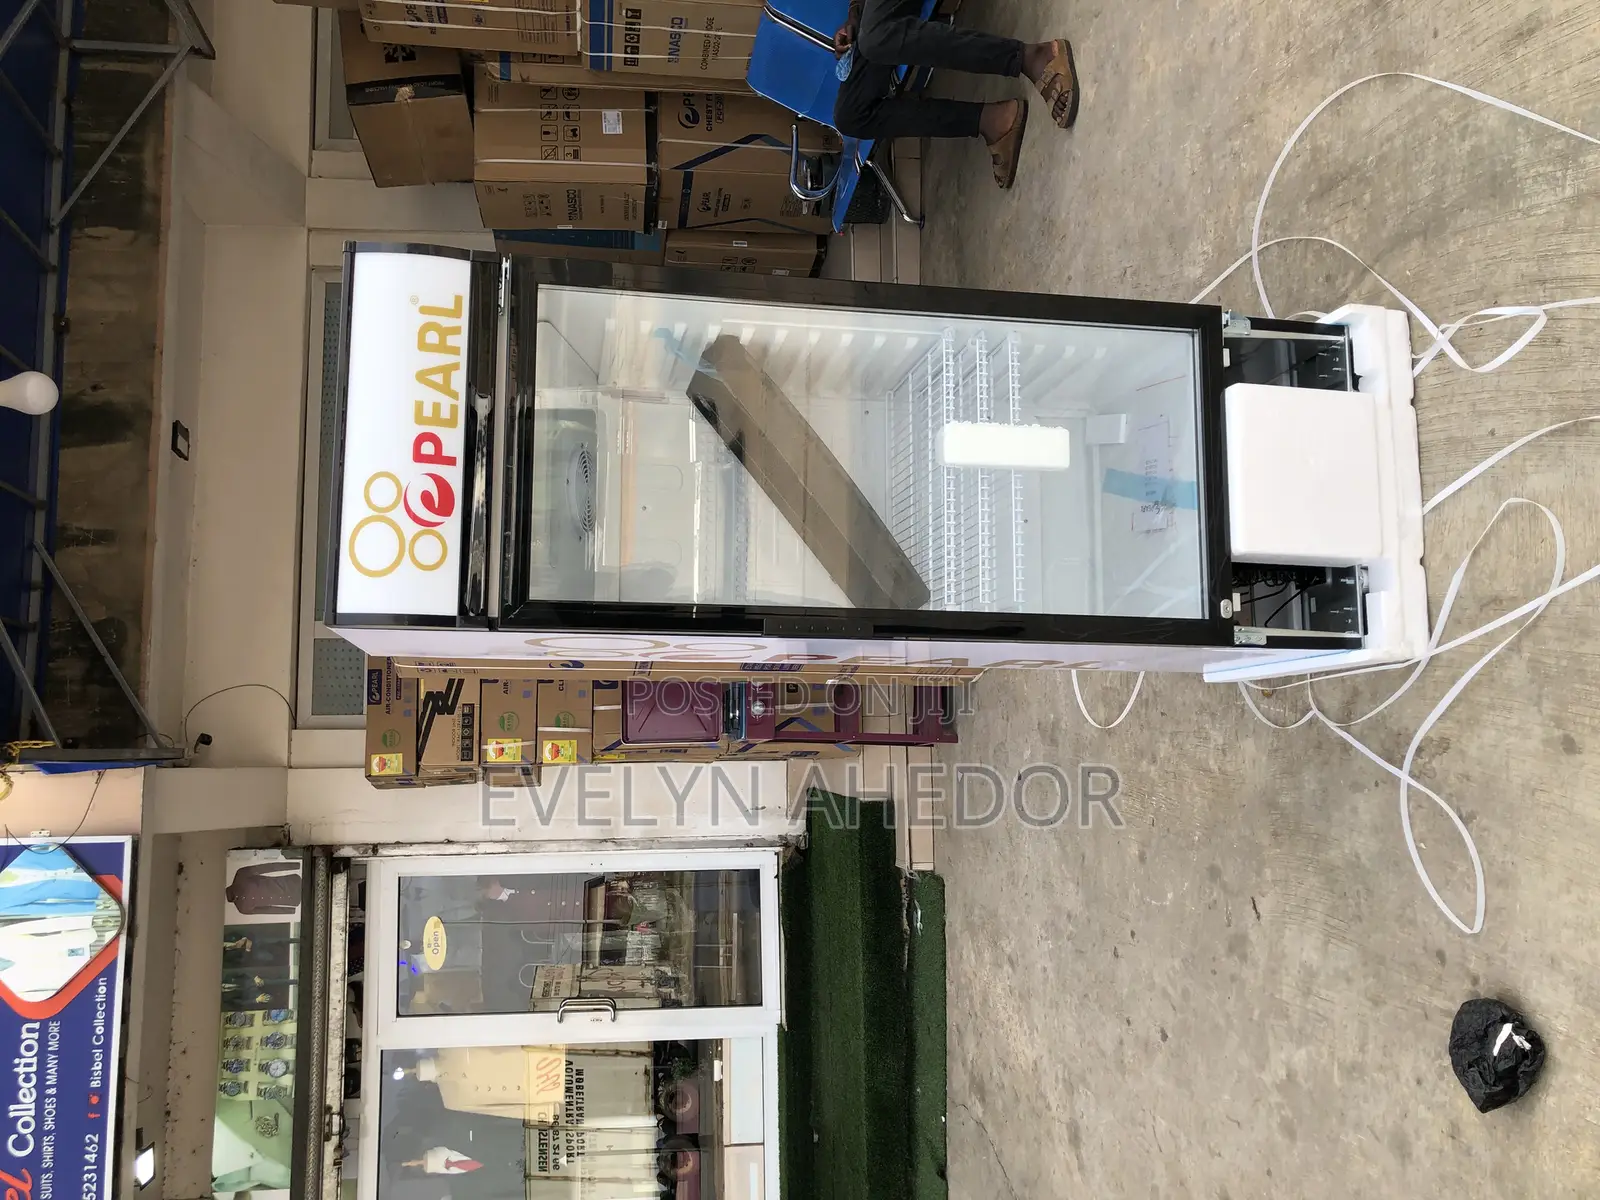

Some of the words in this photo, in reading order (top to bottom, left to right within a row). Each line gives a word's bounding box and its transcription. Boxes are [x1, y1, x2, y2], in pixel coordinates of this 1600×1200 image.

[700, 40, 711, 70] COMBINED
[567, 189, 578, 215] NASCO
[412, 294, 463, 467] PEARL
[432, 931, 440, 954] Open
[93, 977, 108, 1045] Collection
[49, 1020, 60, 1050] MORE
[48, 1054, 59, 1084] MANY
[90, 1050, 104, 1088] Bisbel
[7, 1022, 40, 1157] Collection
[45, 1098, 57, 1130] SHOES
[42, 1133, 56, 1168] SHIRTS,
[83, 1134, 99, 1200] 5231462
[40, 1171, 54, 1200] SUITS,
